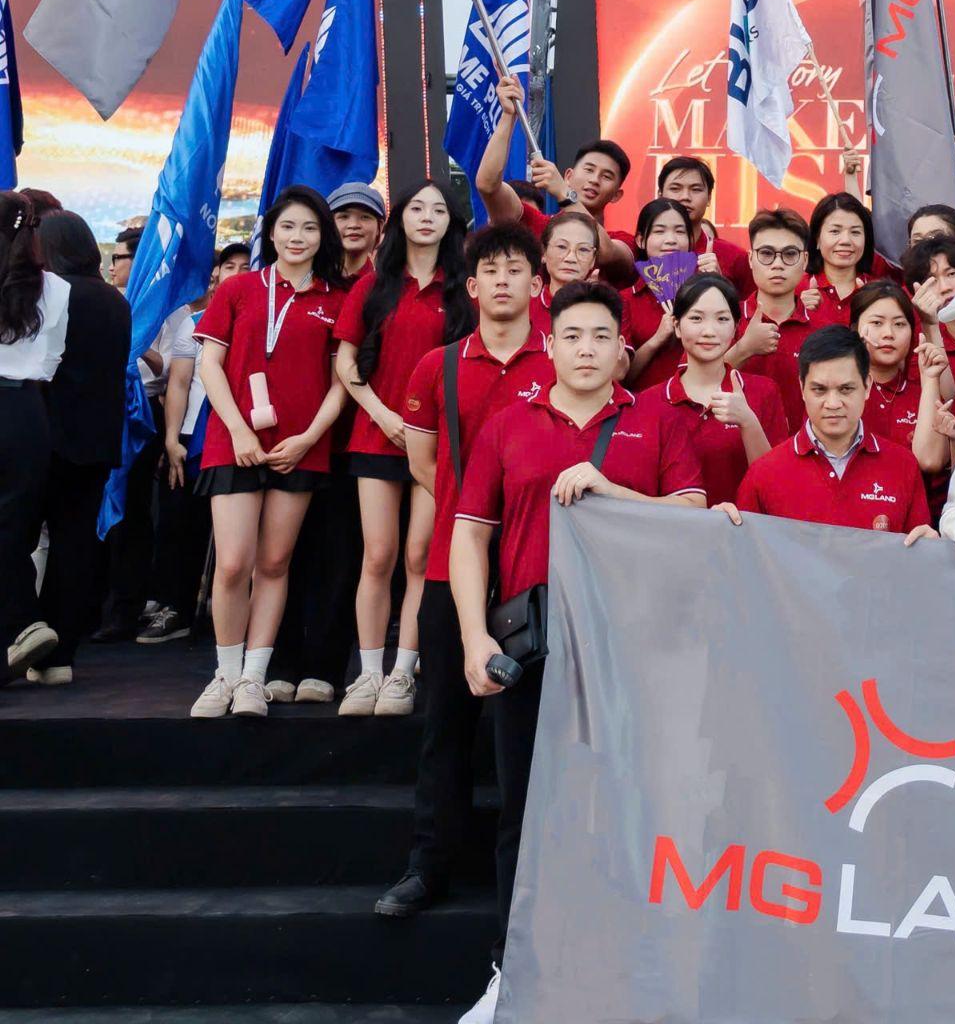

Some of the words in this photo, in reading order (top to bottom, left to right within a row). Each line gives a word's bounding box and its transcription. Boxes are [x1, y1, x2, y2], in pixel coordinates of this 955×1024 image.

[648, 98, 868, 151] MKE
[201, 202, 217, 234] NO
[860, 493, 897, 503] MGLAND
